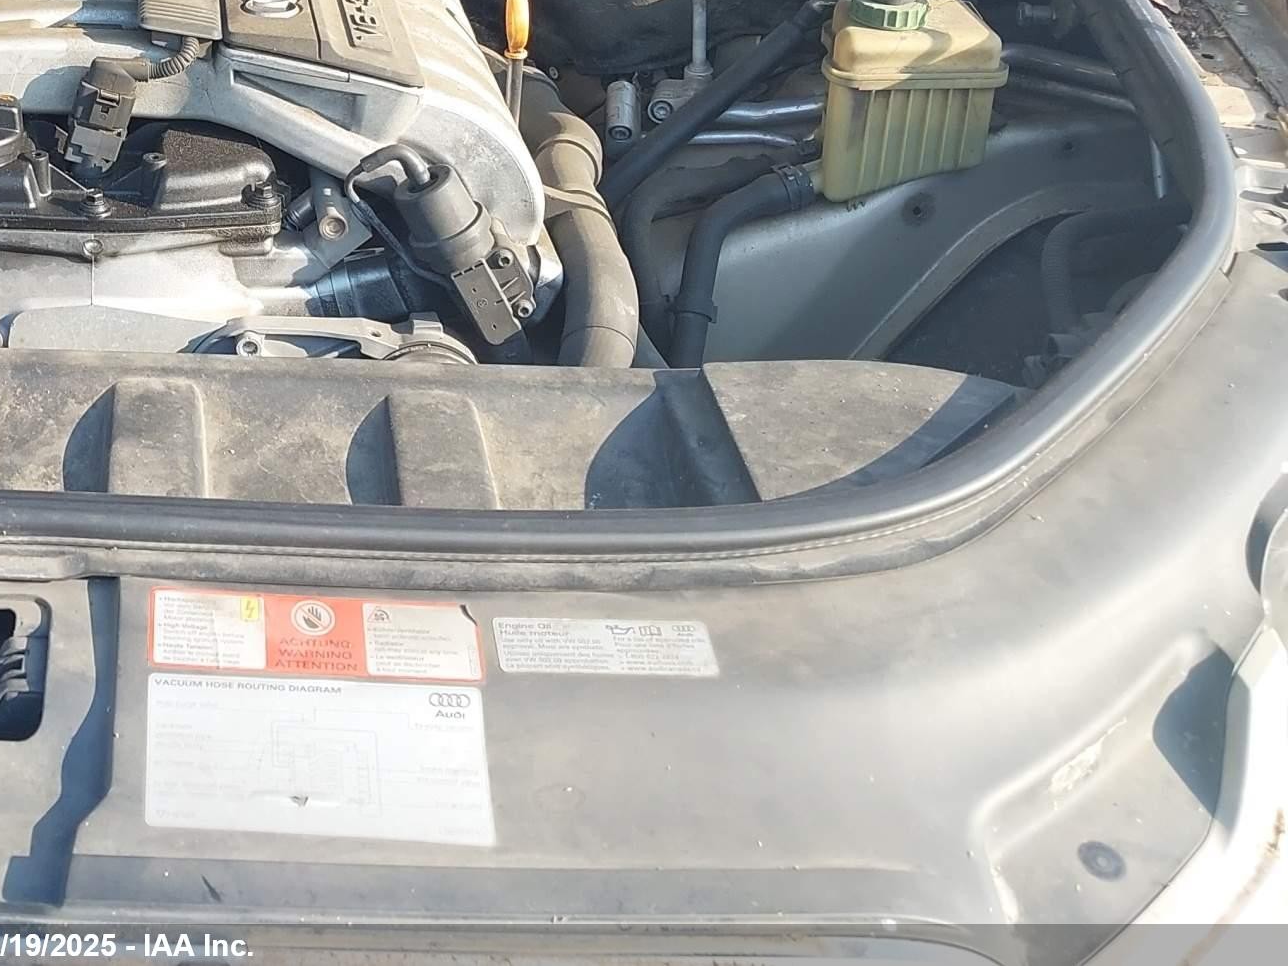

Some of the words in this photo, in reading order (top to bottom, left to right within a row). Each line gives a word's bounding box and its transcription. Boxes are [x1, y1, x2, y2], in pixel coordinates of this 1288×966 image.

[498, 622, 534, 630] Engine
[279, 637, 351, 649] ACHTUNG
[278, 648, 352, 660] WARNING
[275, 659, 357, 671] ATTENTION
[155, 678, 203, 689] VACUUM
[206, 681, 234, 690] HOSE
[237, 682, 286, 692] ROUTING
[288, 684, 342, 694] DIAGRAM
[435, 709, 465, 720] Audi
